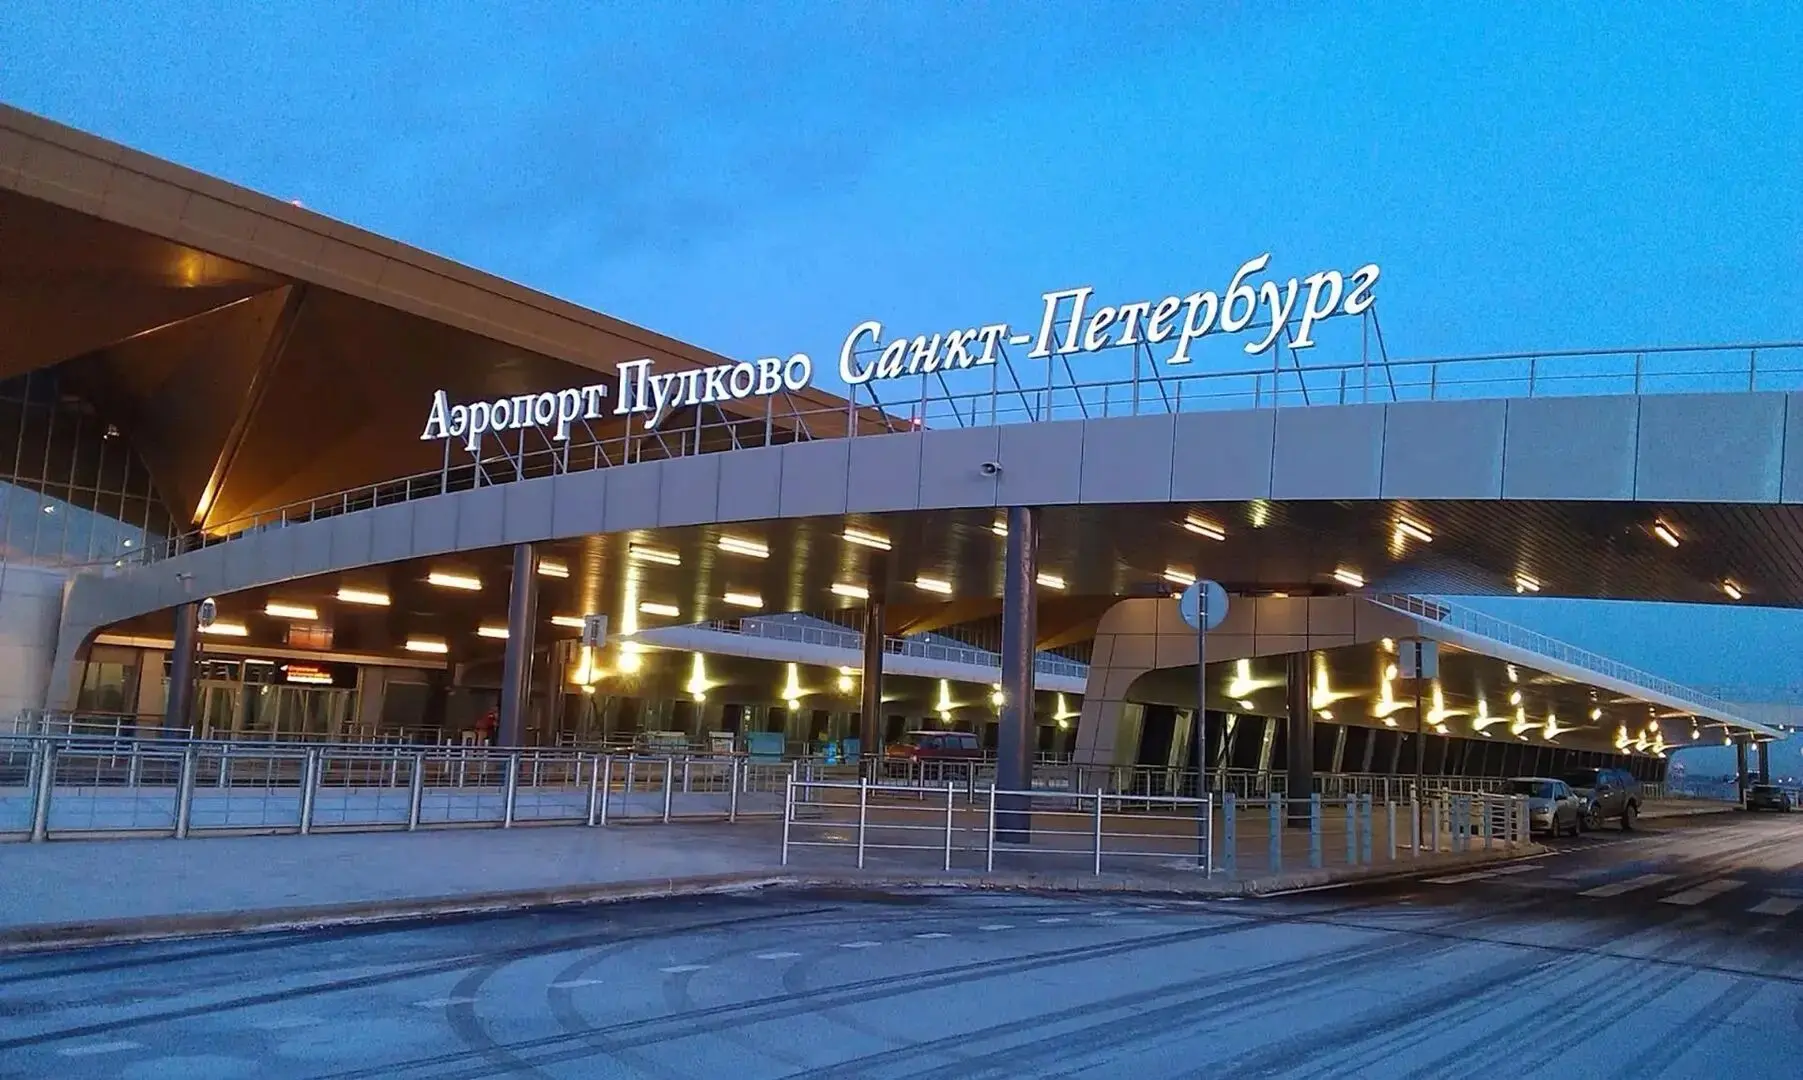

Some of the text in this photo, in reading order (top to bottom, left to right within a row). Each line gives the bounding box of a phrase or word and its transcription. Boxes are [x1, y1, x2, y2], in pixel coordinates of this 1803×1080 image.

[420, 252, 1380, 451] Аэропорт Пулково Санкт-Петербург
